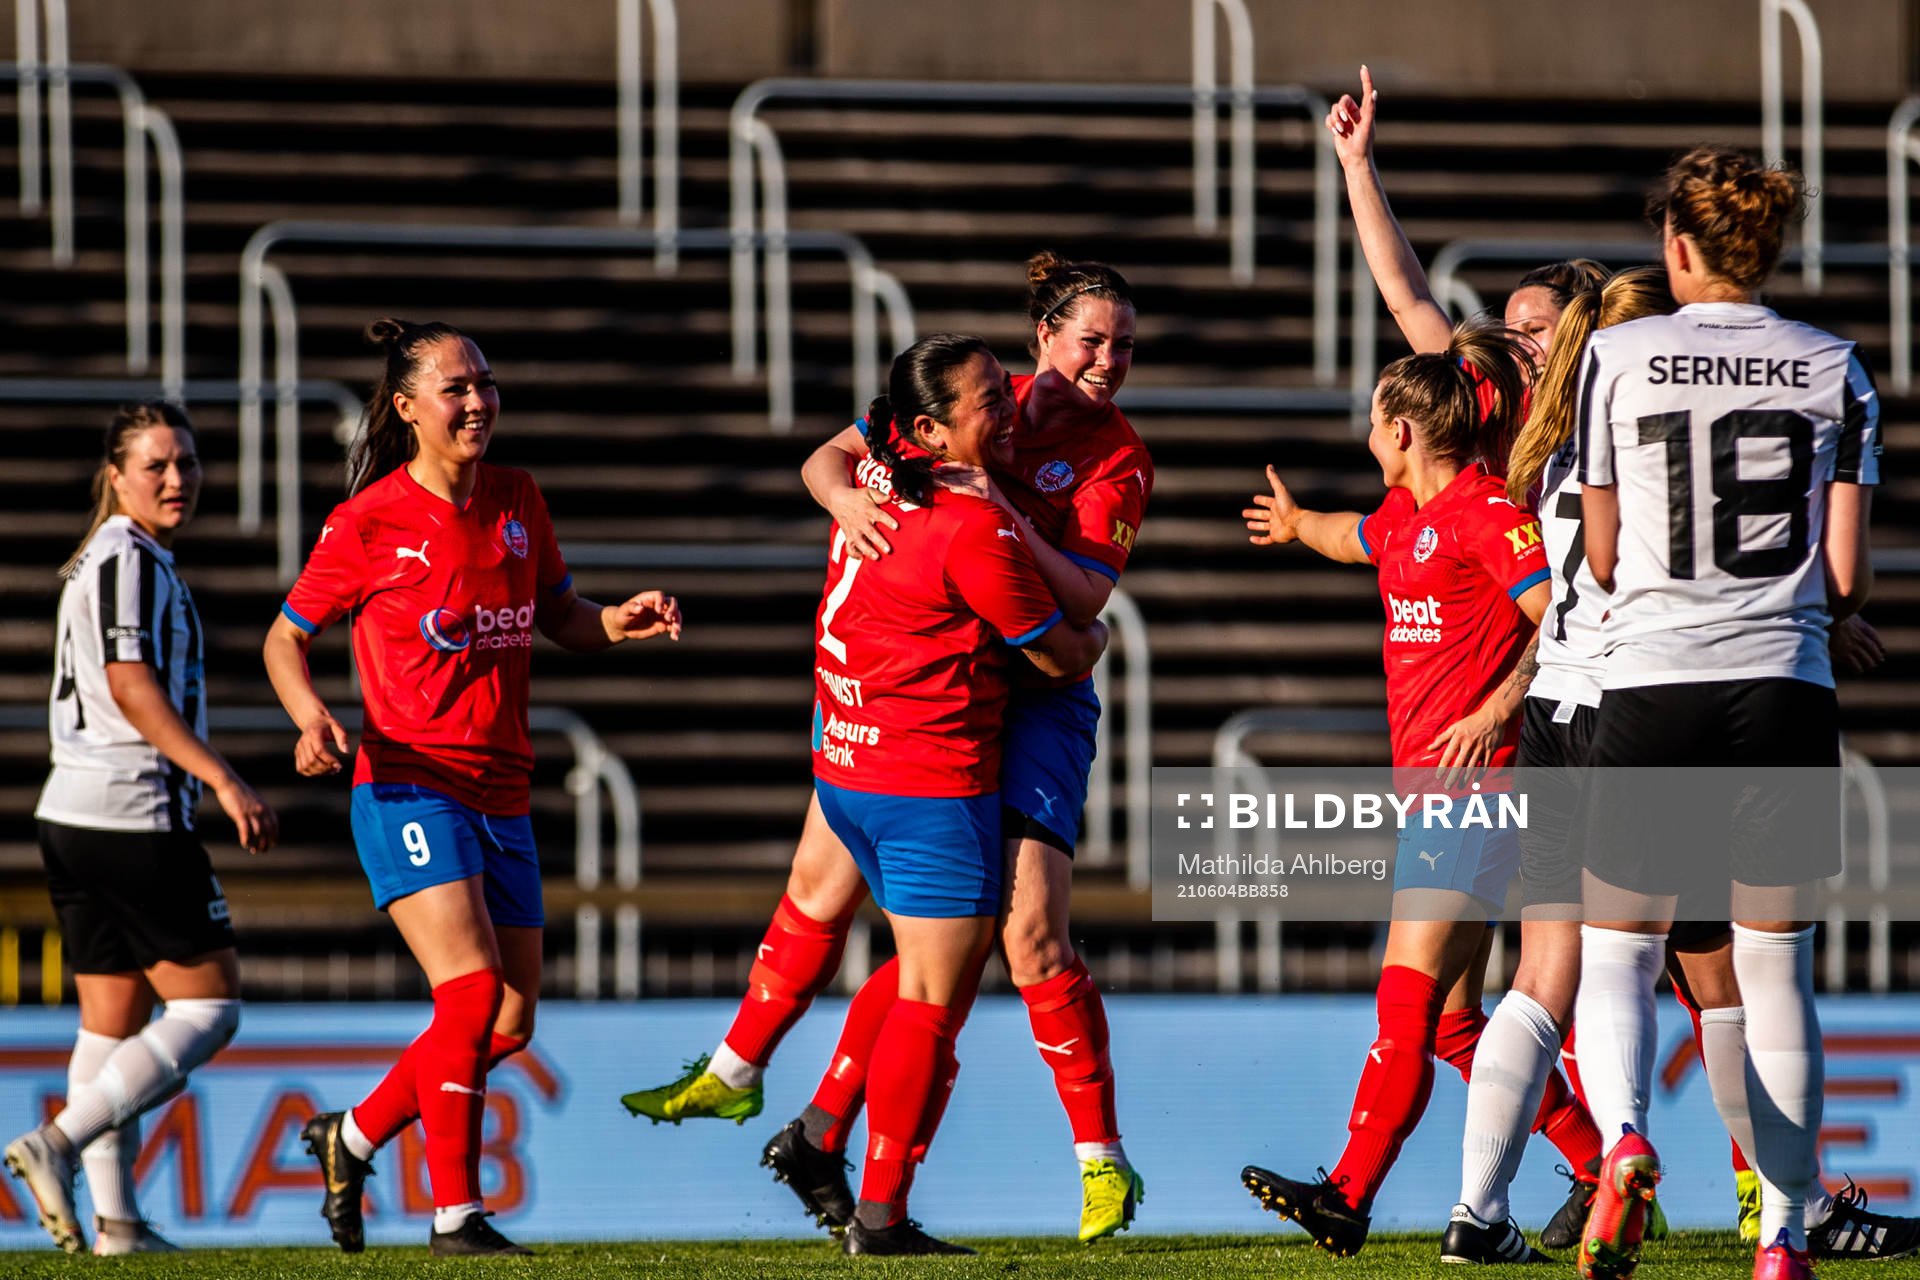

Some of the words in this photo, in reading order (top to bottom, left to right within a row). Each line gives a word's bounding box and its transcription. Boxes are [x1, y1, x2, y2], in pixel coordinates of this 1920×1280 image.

[1648, 355, 1811, 389] SERNEKE
[1638, 409, 1815, 580] 18
[1388, 592, 1443, 625] beat
[1390, 624, 1441, 643] diabetes
[822, 734, 855, 767] Bank
[402, 821, 431, 867] 9
